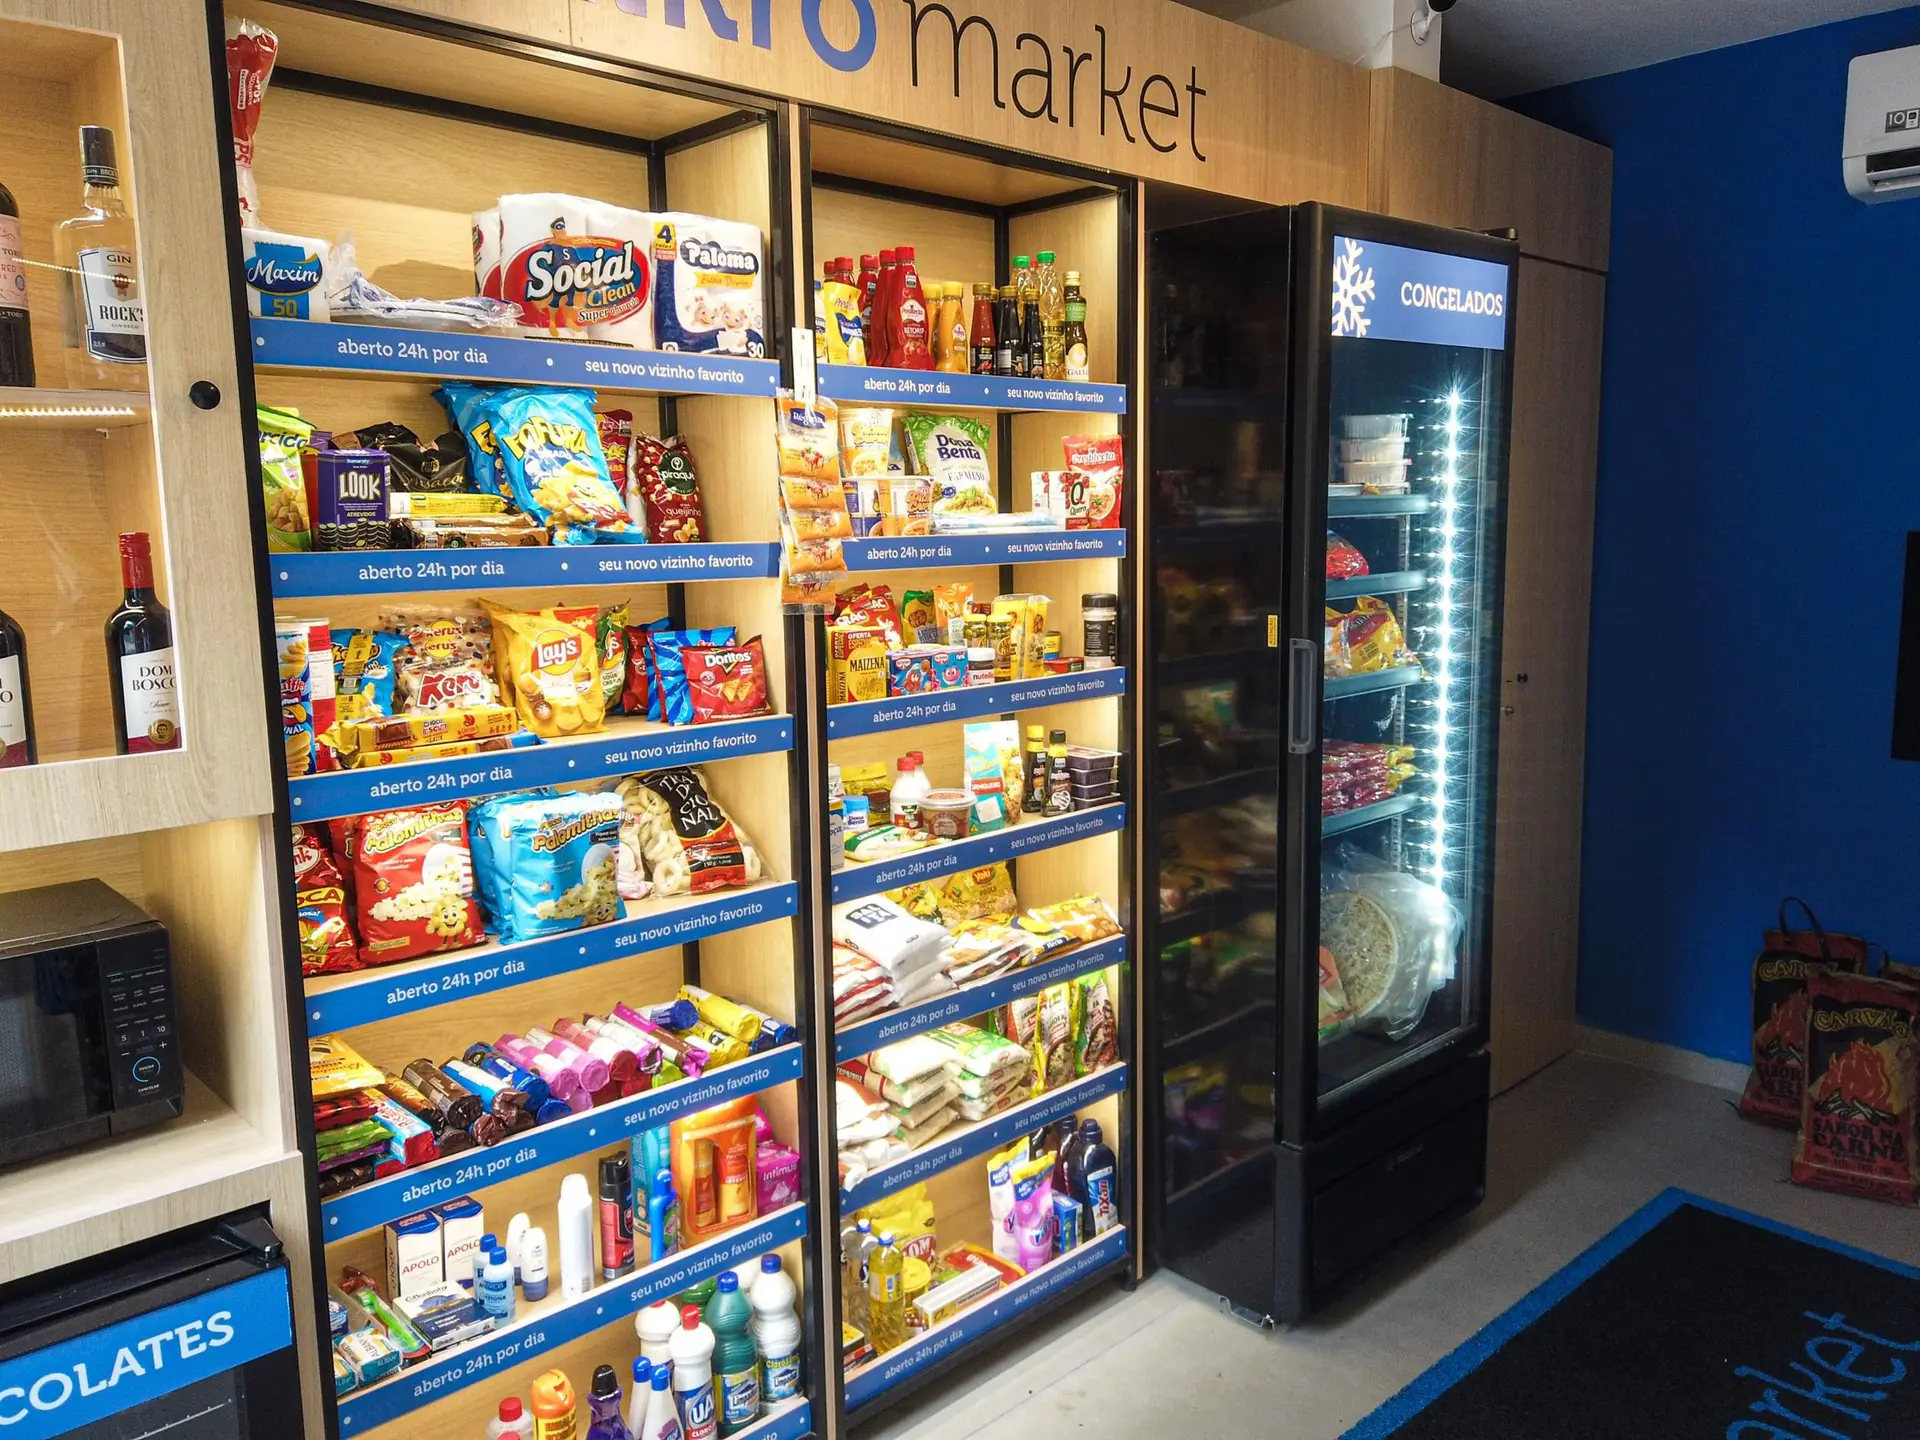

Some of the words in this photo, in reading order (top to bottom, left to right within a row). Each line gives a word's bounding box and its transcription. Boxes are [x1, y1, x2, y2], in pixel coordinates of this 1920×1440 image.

[911, 2, 1207, 162] market
[657, 225, 672, 243] 4
[107, 254, 131, 264] GIN
[684, 241, 756, 271] Paloma
[247, 258, 320, 285] Maxim
[526, 241, 634, 300] Social
[587, 281, 635, 308] Clean
[1401, 281, 1503, 317] CONGELADOS
[273, 298, 297, 318] 50
[578, 308, 609, 322] Super
[338, 339, 393, 356] aberto
[398, 343, 428, 359] 24h
[433, 349, 459, 363] por
[464, 348, 488, 363] dia
[747, 341, 764, 358] 30
[586, 361, 609, 372] seu
[612, 363, 645, 375] novo
[648, 364, 695, 379] vizinho
[698, 367, 744, 383] favorito
[865, 378, 896, 390] aberto
[899, 380, 916, 391] 24h
[918, 384, 934, 394] por
[937, 382, 950, 393] dia
[1008, 389, 1021, 397] seu
[1024, 390, 1043, 399] novo
[1045, 390, 1073, 401] vizinho
[1075, 391, 1103, 402] favorito
[501, 415, 594, 462] FOFURA
[936, 434, 974, 447] Dona
[936, 446, 981, 461] Benta
[338, 470, 382, 500] LOOK
[1070, 506, 1087, 516] Quero
[868, 548, 898, 559] aberto
[901, 547, 917, 558] 24h
[920, 549, 936, 559] por
[938, 546, 951, 556] dia
[1008, 545, 1021, 553] seu
[1024, 544, 1043, 552] novo
[1045, 540, 1073, 550] vizinho
[1075, 540, 1103, 549] favorito
[359, 565, 412, 579] aberto
[418, 563, 446, 577] 24h
[451, 564, 477, 582] por
[482, 561, 504, 575] dia
[599, 561, 622, 571] seu
[626, 560, 657, 569] novo
[661, 556, 705, 568] vizinho
[709, 555, 753, 567] favorito
[847, 631, 872, 641] OFERTA
[537, 637, 578, 668] Lay's
[704, 651, 752, 668] Doritos
[849, 657, 885, 672] MAIZENA
[140, 664, 172, 678] DOM
[1011, 693, 1025, 701] seu
[1027, 690, 1046, 699] novo
[1048, 684, 1075, 695] vizinho
[1077, 680, 1104, 691] favorito
[874, 710, 903, 722] aberto
[906, 706, 923, 717] 24h
[925, 705, 940, 717] por
[943, 701, 956, 712] dia
[606, 752, 628, 764] seu
[631, 747, 662, 759] novo
[666, 739, 709, 754] vizinho
[713, 734, 756, 748] favorito
[371, 780, 422, 797] aberto
[428, 774, 456, 789] 24h
[460, 772, 486, 788] por
[490, 767, 512, 780] dia
[680, 806, 719, 828] NAL
[365, 809, 462, 853] Palomithas
[1011, 839, 1024, 848] seu
[1027, 834, 1045, 844] novo
[1047, 826, 1074, 839] vizinho
[1076, 819, 1103, 831] favorito
[876, 869, 906, 883] aberto
[908, 862, 924, 875] 24h
[927, 860, 941, 872] por
[944, 856, 957, 866] dia
[973, 869, 993, 883] Yoki
[615, 934, 637, 947] seu
[640, 926, 671, 941] novo
[674, 915, 717, 932] vizinho
[720, 904, 762, 921] favorito
[387, 983, 438, 1004] aberto
[443, 973, 470, 990] 24h
[474, 968, 499, 985] por
[503, 962, 525, 975] dia
[1013, 981, 1026, 991] seu
[1028, 974, 1047, 987] novo
[1048, 964, 1076, 981] vizinho
[1077, 953, 1104, 970] favorito
[879, 1022, 908, 1038] aberto
[911, 1014, 927, 1027] 24h
[929, 1010, 944, 1023] por
[946, 1004, 959, 1014] dia
[625, 1111, 646, 1125] seu
[649, 1100, 679, 1117] novo
[682, 1085, 724, 1105] vizinho
[727, 1069, 769, 1090] favorito
[1015, 1118, 1028, 1129] seu
[1030, 1109, 1048, 1122] novo
[1050, 1096, 1077, 1115] vizinho
[1078, 1083, 1105, 1101] favorito
[402, 1179, 452, 1203] aberto
[456, 1165, 483, 1183] 24h
[487, 1157, 511, 1176] por
[516, 1149, 537, 1163] dia
[763, 1163, 798, 1182] Intimus
[883, 1169, 912, 1189] aberto
[914, 1160, 930, 1174] 24h
[933, 1154, 946, 1168] por
[949, 1148, 962, 1158] dia
[446, 1239, 481, 1258] APOLO
[401, 1255, 440, 1275] APOLO
[631, 1285, 652, 1301] seu
[655, 1271, 684, 1290] novo
[686, 1252, 729, 1274] vizinho
[731, 1232, 773, 1255] favorito
[1015, 1293, 1028, 1305] seu
[1030, 1281, 1048, 1296] novo
[1050, 1266, 1076, 1285] vizinho
[1076, 1249, 1105, 1271] favorito
[414, 1369, 463, 1397] aberto
[467, 1355, 492, 1373] 24h
[496, 1343, 520, 1363] por
[524, 1333, 545, 1348] dia
[885, 1358, 913, 1379] aberto
[916, 1346, 932, 1362] 24h
[934, 1337, 948, 1353] por
[950, 1329, 963, 1342] dia
